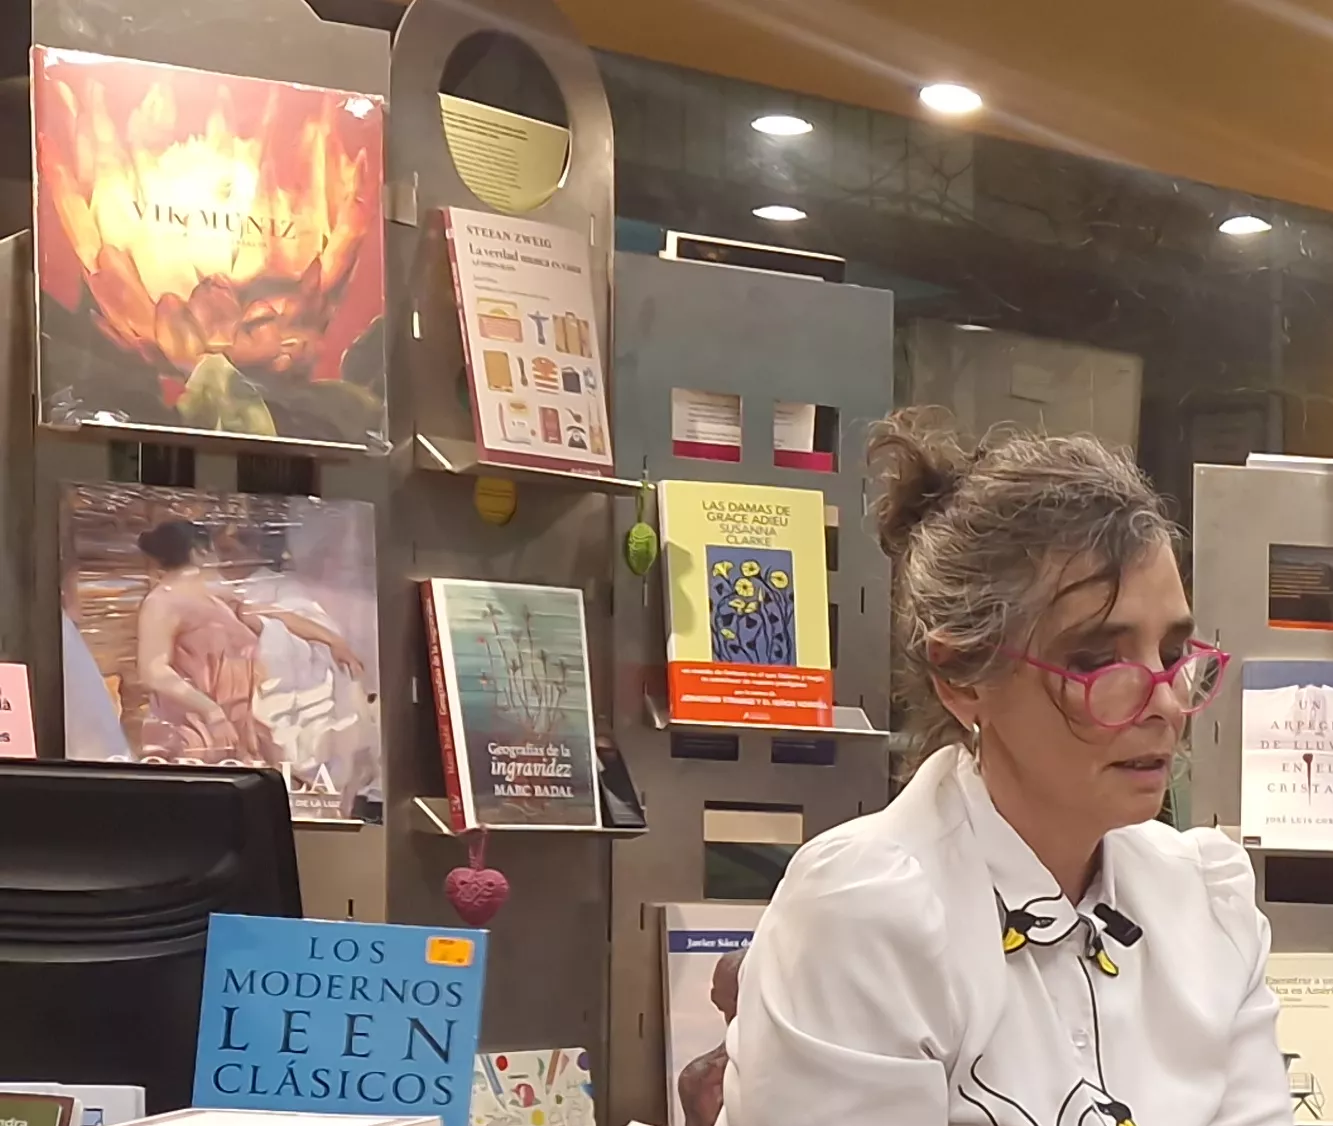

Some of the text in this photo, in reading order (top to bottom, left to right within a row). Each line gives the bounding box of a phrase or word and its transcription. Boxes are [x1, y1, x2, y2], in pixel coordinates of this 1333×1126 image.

[466, 225, 552, 248] STEFAN ZWEIG
[702, 500, 725, 513] LAS
[728, 502, 772, 516] DAMAS
[706, 511, 789, 526] GRACE ADIEU
[719, 523, 777, 537] SUSANNA
[725, 534, 772, 547] CLARKE
[487, 742, 543, 759] Geografías
[489, 758, 572, 782] ingravidez
[493, 783, 574, 799] MARC BADAL
[308, 936, 386, 965] LOS
[686, 937, 716, 949] Javier
[221, 967, 464, 1010] MODERNOS
[218, 1006, 458, 1064] LEEN
[212, 1059, 455, 1106] CLÁSICOS
